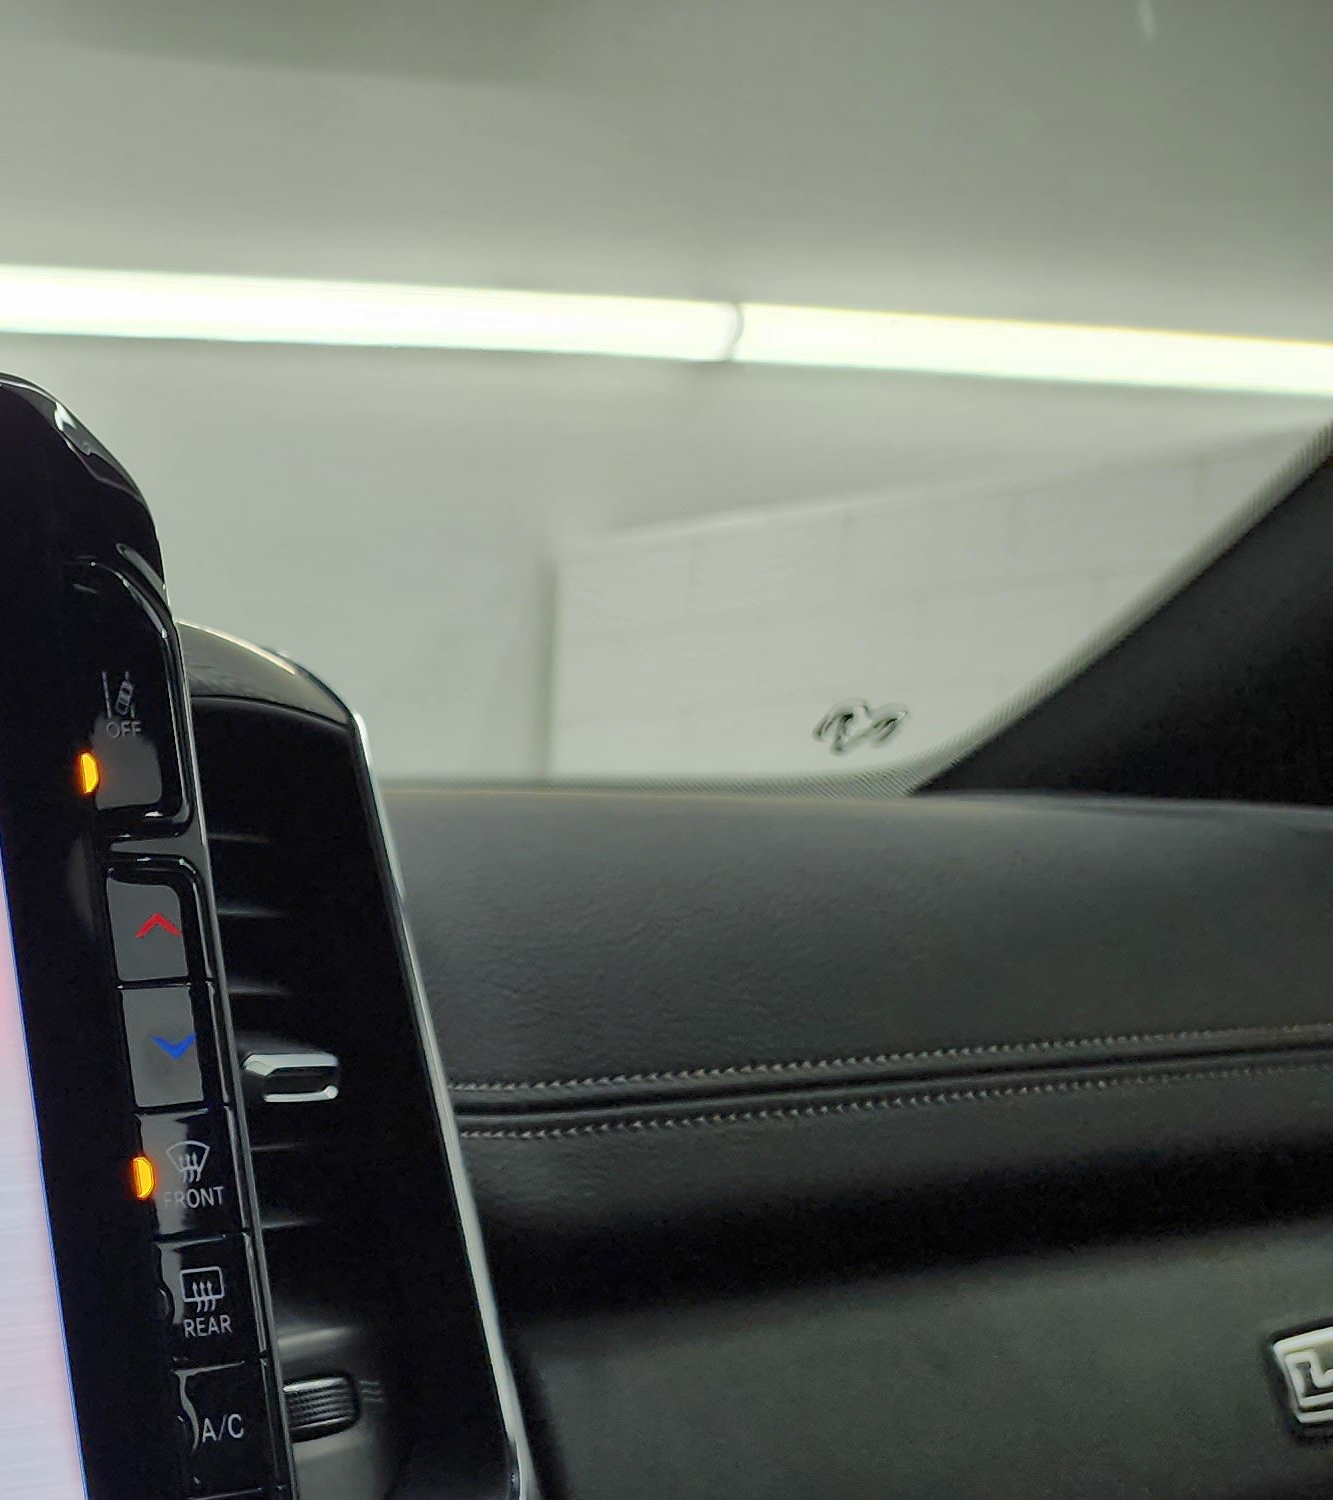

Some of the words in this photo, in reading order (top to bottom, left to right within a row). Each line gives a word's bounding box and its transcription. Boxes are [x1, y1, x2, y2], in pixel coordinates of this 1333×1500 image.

[106, 720, 142, 738] OFF
[164, 1186, 224, 1209] FRONT
[183, 1314, 232, 1339] REAR
[201, 1413, 245, 1444] A/C
